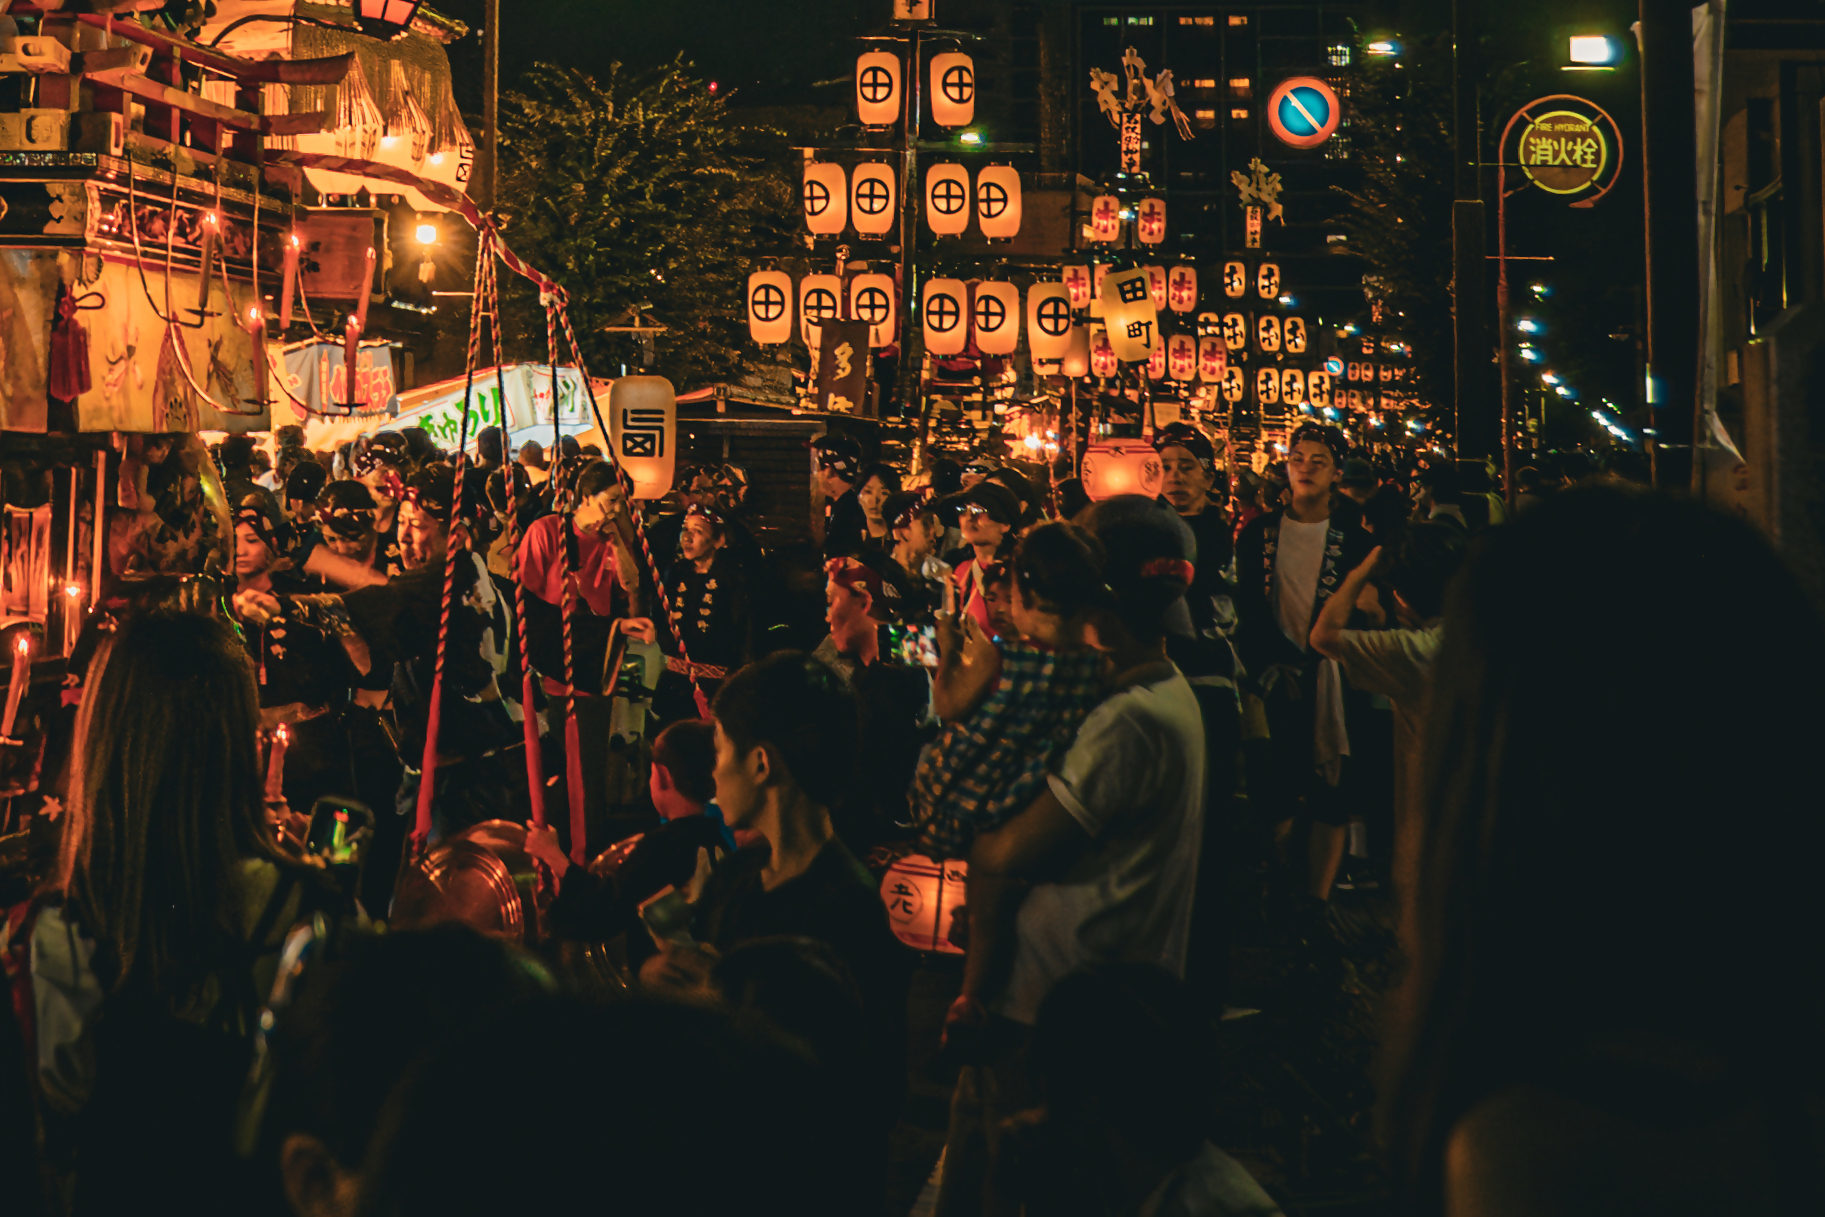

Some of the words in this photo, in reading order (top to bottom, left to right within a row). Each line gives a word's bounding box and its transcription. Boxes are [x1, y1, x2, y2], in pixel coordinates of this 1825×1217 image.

[1535, 122, 1552, 132] FIRE
[1554, 122, 1590, 132] HYDRANT
[1529, 137, 1598, 168] 消火栓
[1117, 276, 1152, 349] 田町
